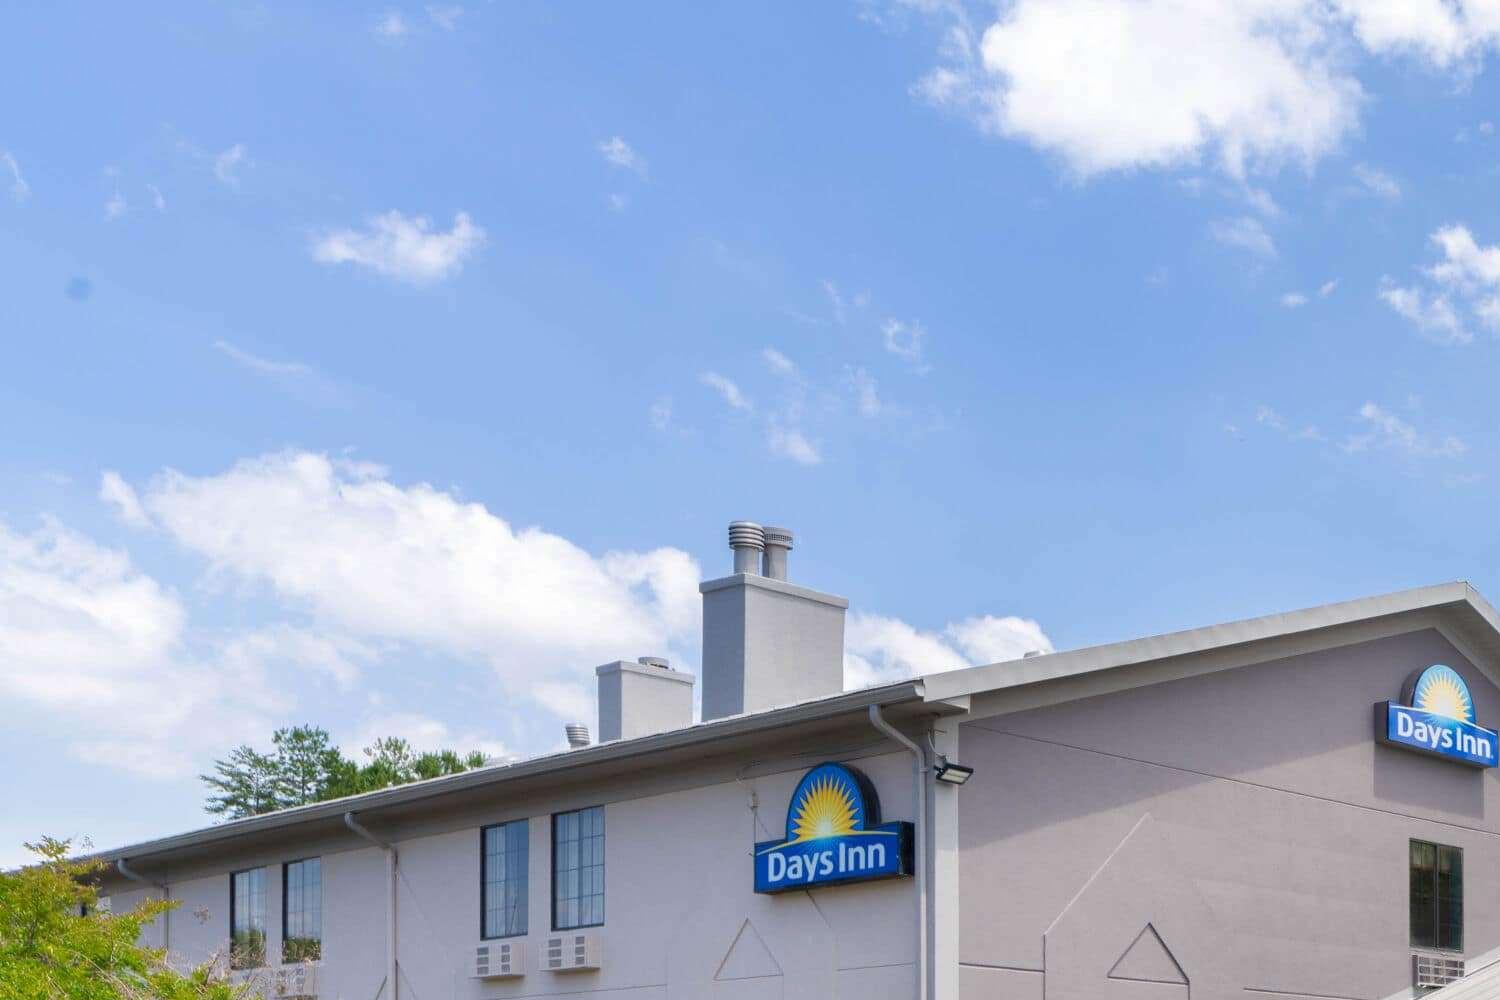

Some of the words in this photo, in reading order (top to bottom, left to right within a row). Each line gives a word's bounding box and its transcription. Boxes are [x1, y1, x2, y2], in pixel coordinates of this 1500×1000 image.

[1397, 711, 1453, 749] Days
[1456, 727, 1491, 759] Inn
[768, 850, 833, 882] Days
[838, 842, 885, 872] Inn
